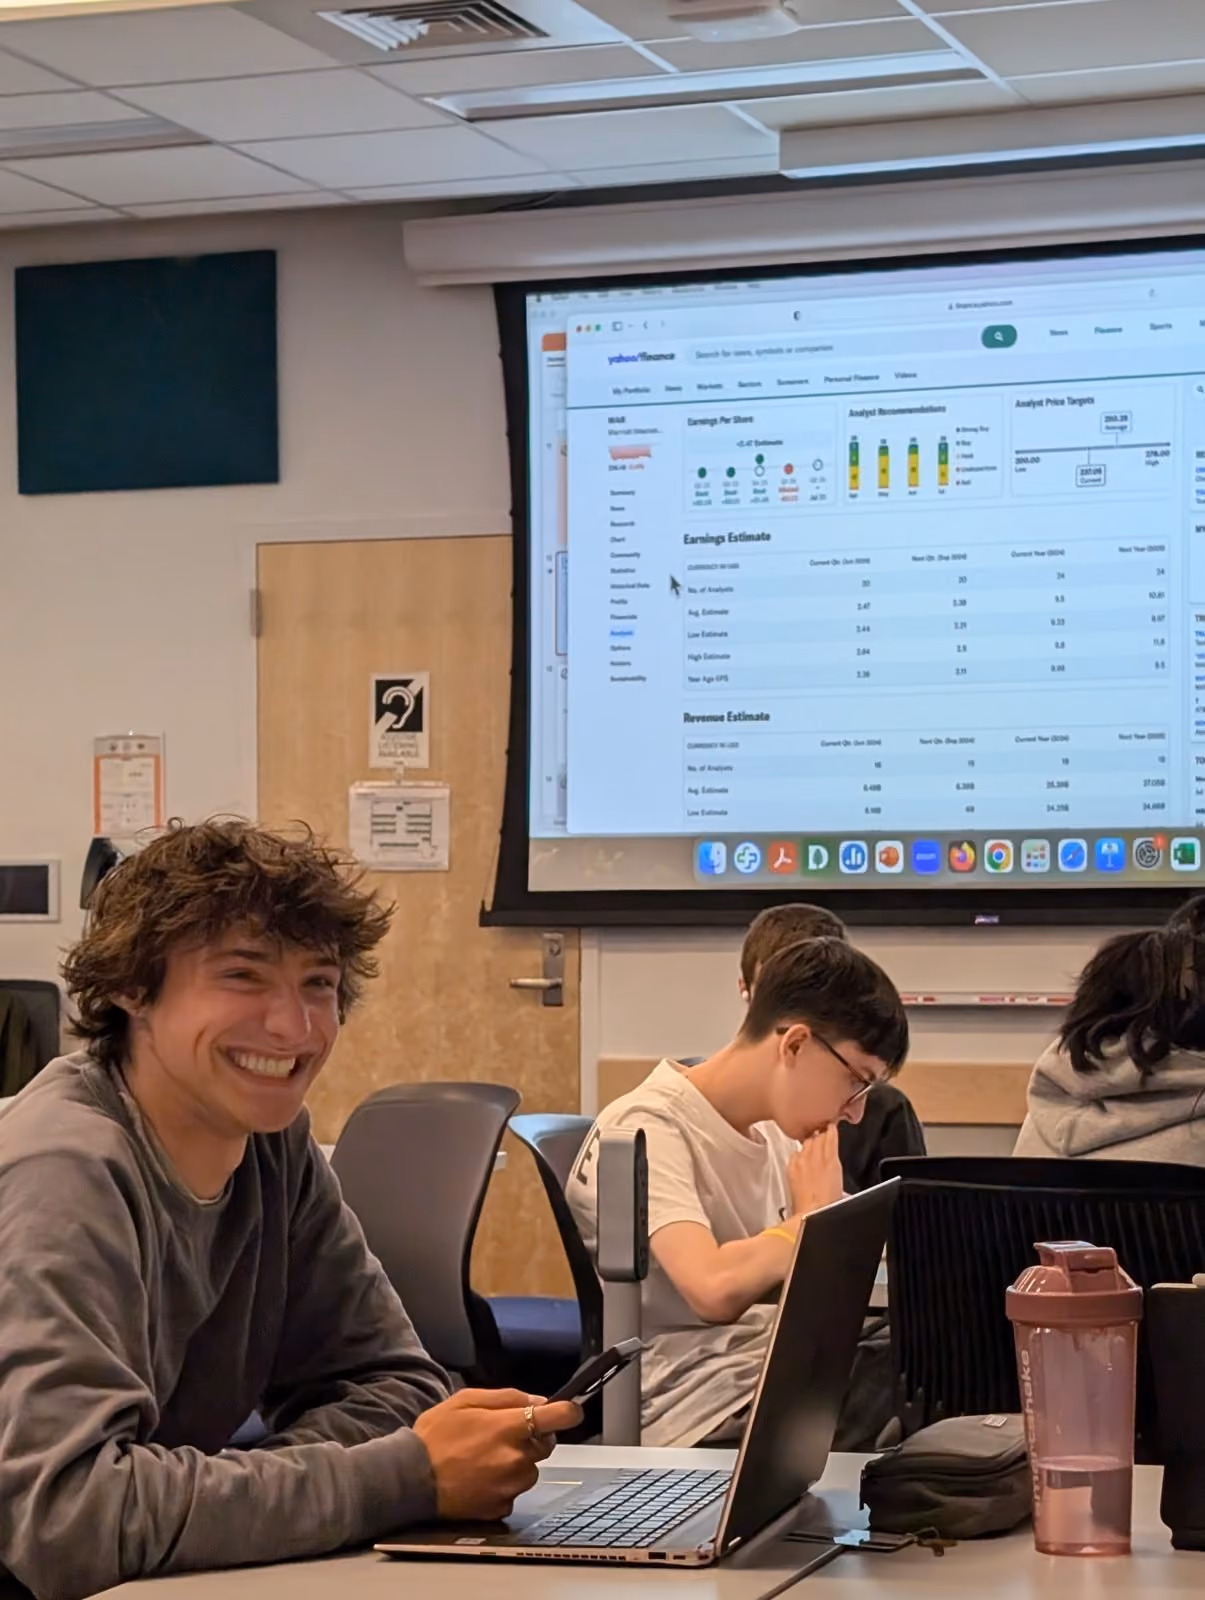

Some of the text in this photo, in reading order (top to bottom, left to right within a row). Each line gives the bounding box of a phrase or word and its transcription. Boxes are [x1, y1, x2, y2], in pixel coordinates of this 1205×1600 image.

[684, 532, 771, 546] Earnings Estimate
[683, 711, 770, 723] Revenue Estimate
